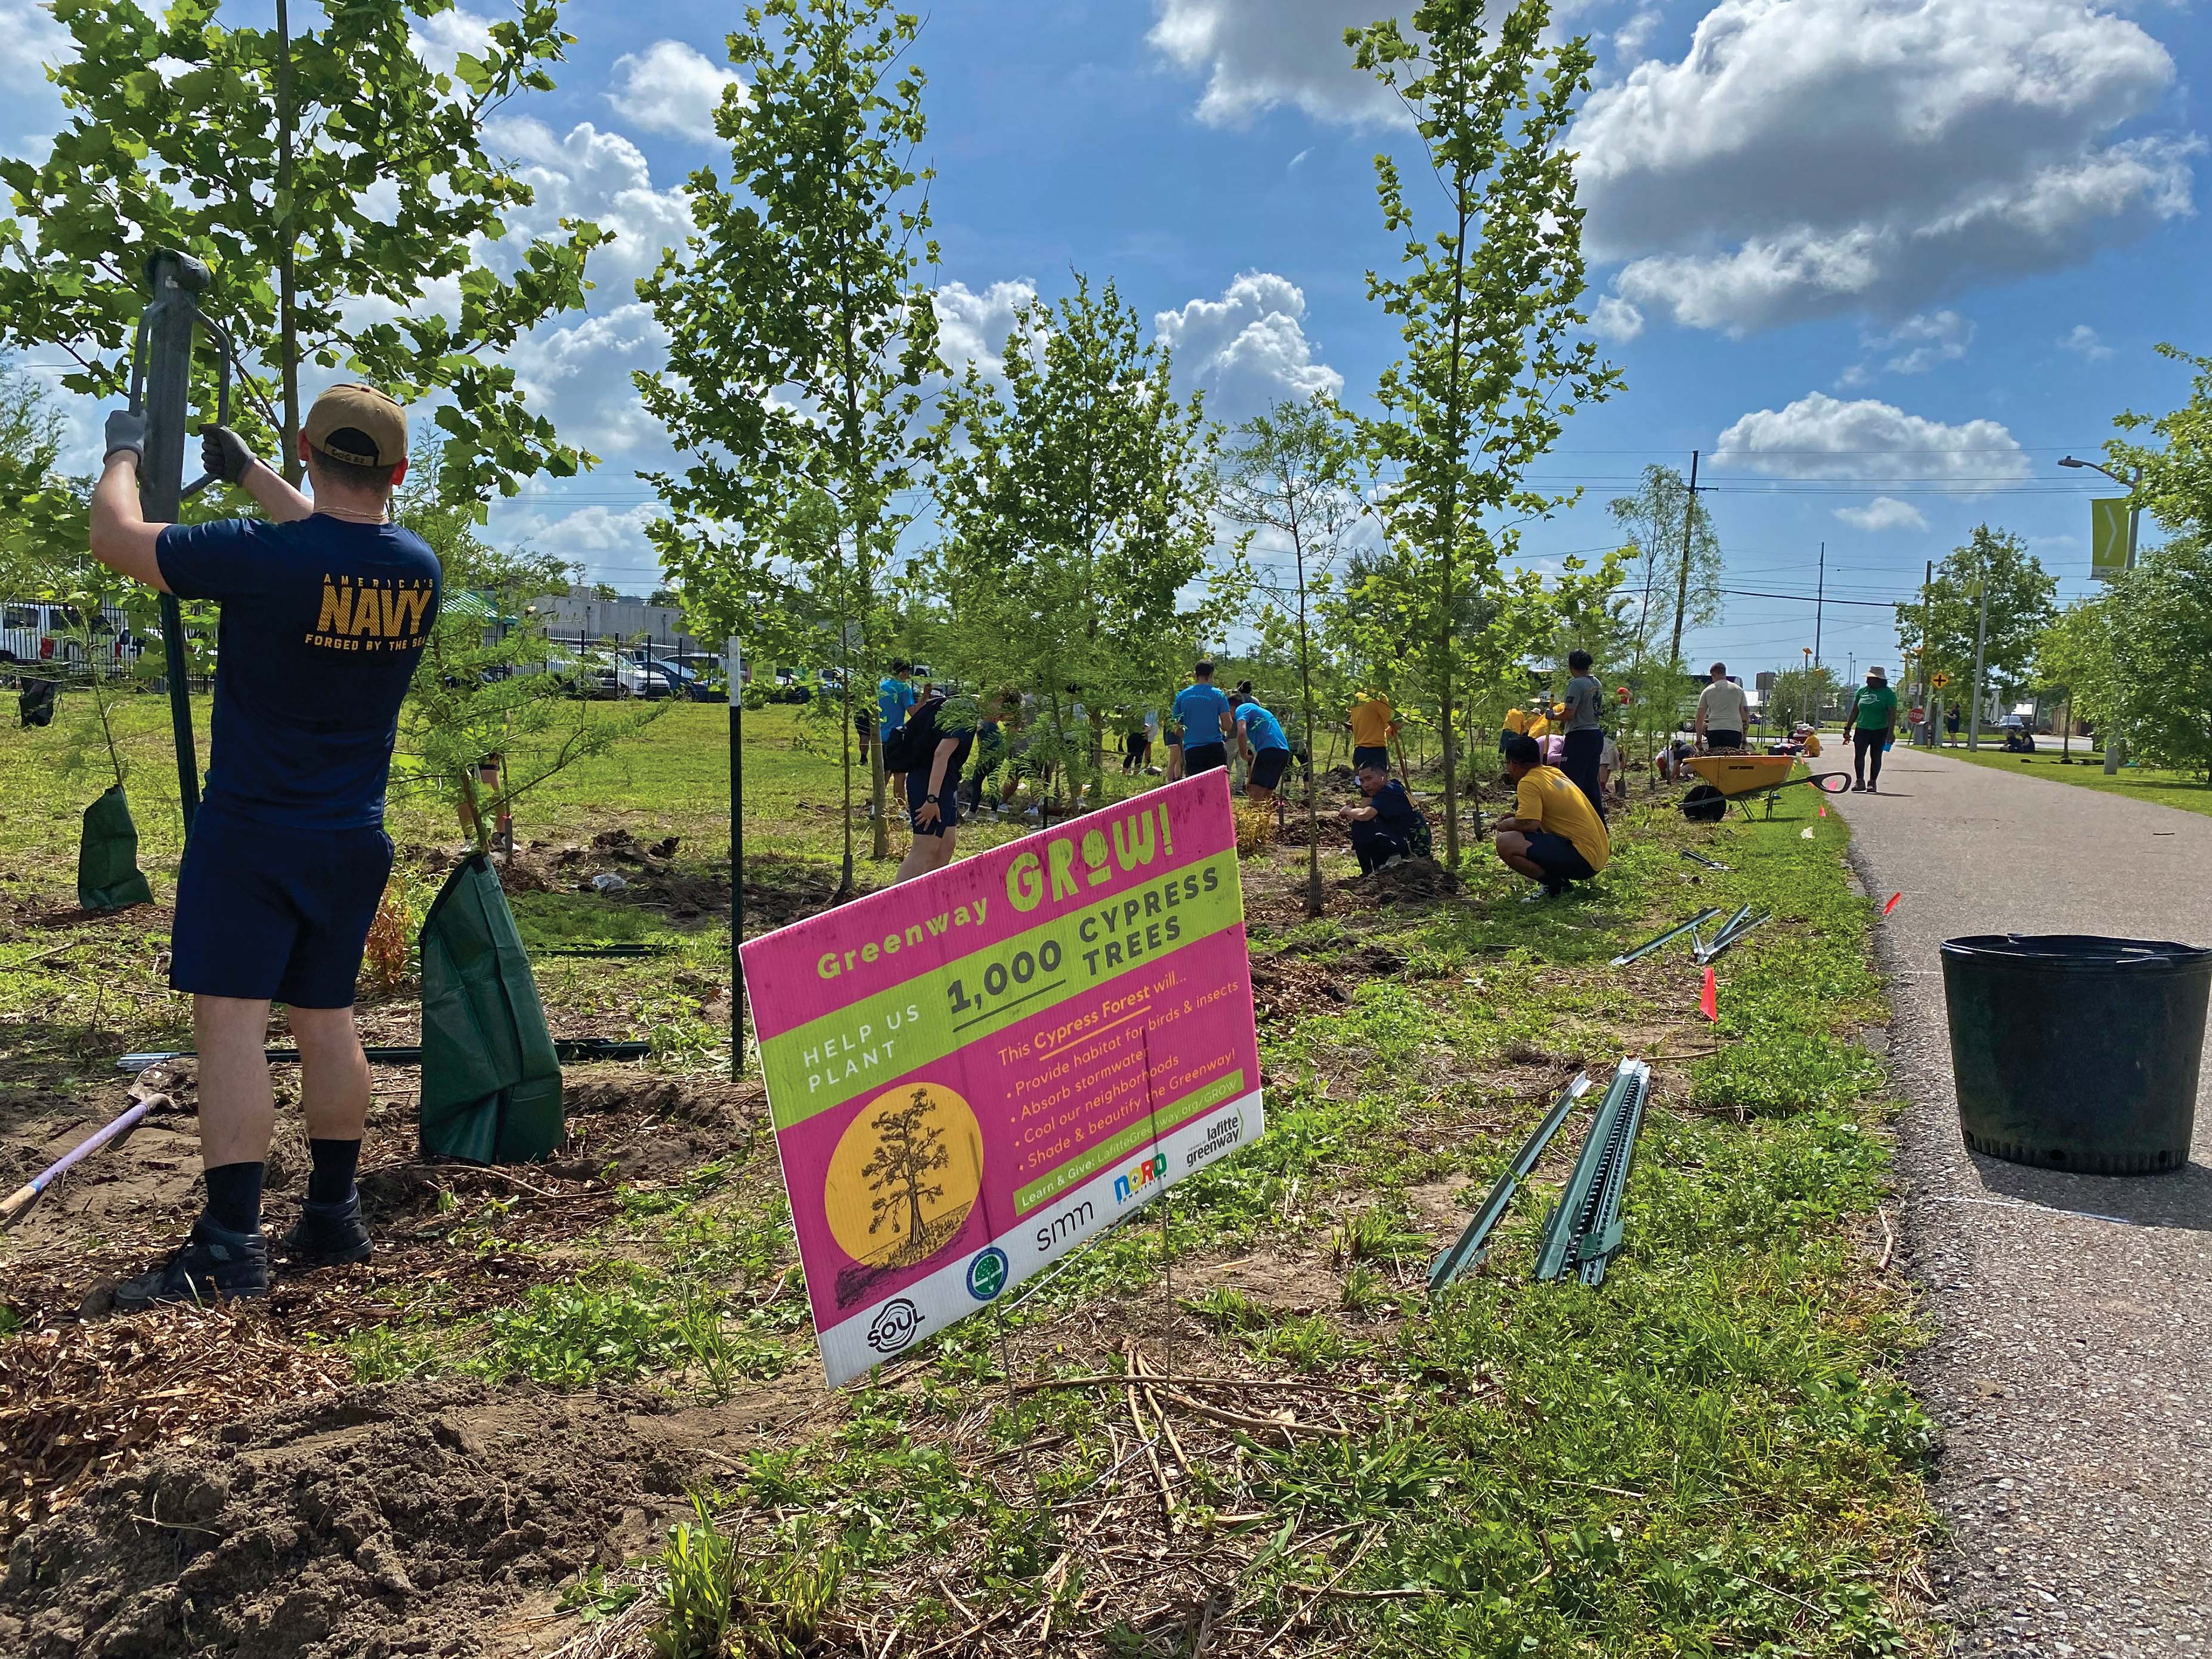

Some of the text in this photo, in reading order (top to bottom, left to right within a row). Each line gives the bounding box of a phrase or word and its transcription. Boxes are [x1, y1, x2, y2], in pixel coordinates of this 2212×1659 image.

[324, 573, 433, 589] AMERICA'S
[317, 585, 432, 637] NAVY
[305, 634, 358, 651] FORGED
[366, 640, 382, 651] BY
[389, 639, 407, 651] THE
[1079, 866, 1219, 943] CYPRESS
[818, 897, 988, 979] Greenway
[1082, 915, 1180, 976] TREES
[947, 940, 1062, 1016] 1,000
[803, 1005, 919, 1067] HELP US
[997, 1041, 1031, 1066] This
[1034, 1010, 1099, 1052] Cypress
[1102, 986, 1150, 1017] Forest
[1016, 981, 1239, 1097] Provide habitat for birds & insects
[808, 1040, 895, 1093] PLANT
[1020, 1085, 1071, 1121] Absorb
[1025, 1054, 1179, 1144] Cool our neighborhoods
[1028, 1048, 1236, 1168] Shade & beautify the Greenway!
[1186, 1128, 1239, 1168] greenway
[1207, 1116, 1239, 1141] lafitte
[1022, 1183, 1054, 1207] Learn
[1057, 1175, 1065, 1186] &
[1068, 1159, 1095, 1179] Give:
[867, 1308, 926, 1348] SOUL
